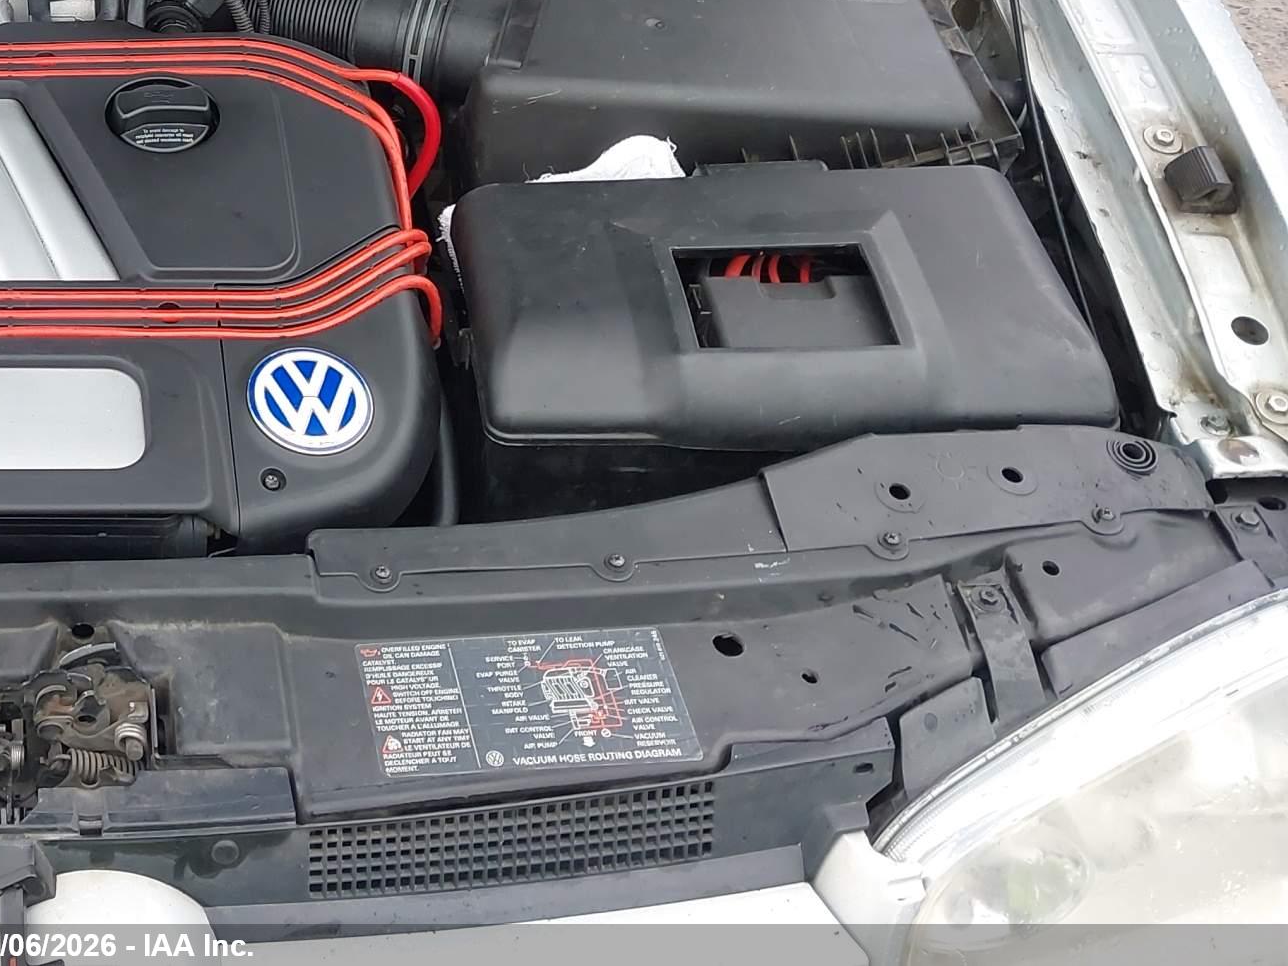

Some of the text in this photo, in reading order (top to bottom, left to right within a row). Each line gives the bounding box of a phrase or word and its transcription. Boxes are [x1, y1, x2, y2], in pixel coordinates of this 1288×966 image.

[512, 748, 682, 765] VACUUM HOSE ROUTING DIAGRAM
